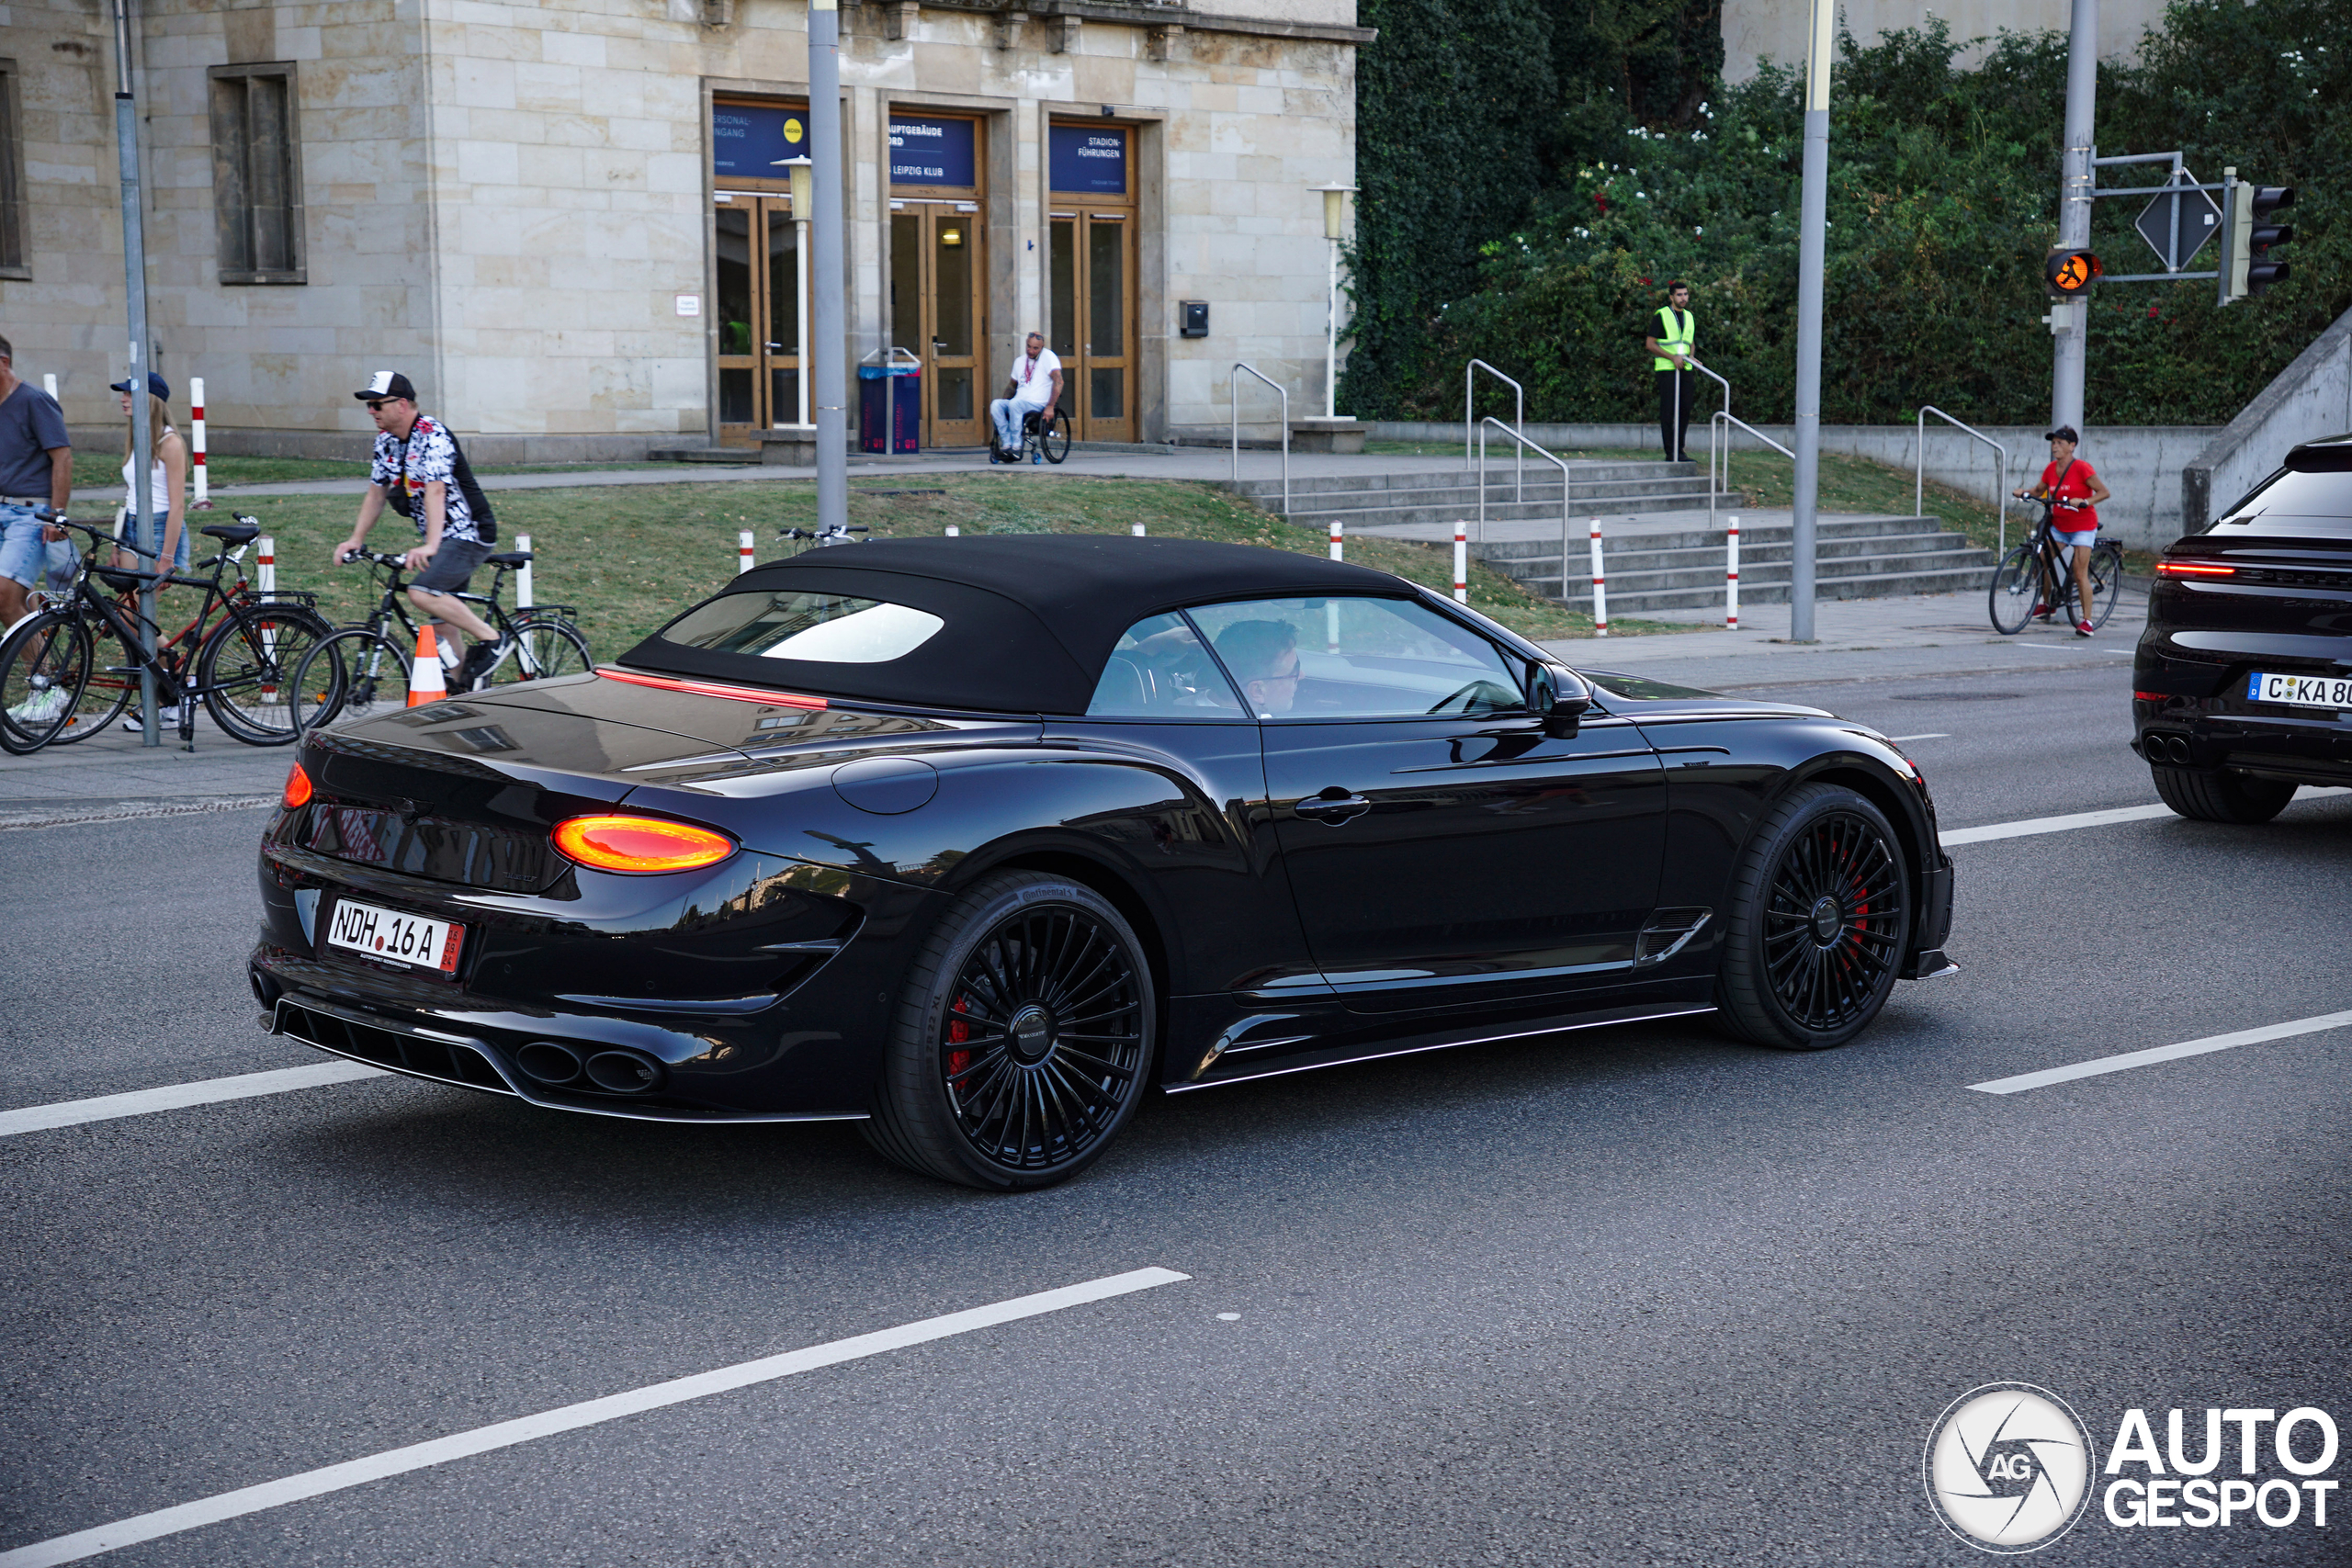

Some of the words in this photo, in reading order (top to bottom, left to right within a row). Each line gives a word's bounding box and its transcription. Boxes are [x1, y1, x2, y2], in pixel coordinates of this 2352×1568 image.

[1088, 137, 1121, 146] STADION-
[1078, 146, 1120, 158] FÜHRUNGEN
[893, 165, 922, 175] LEIPZIG
[923, 167, 944, 176] KLUB
[2268, 677, 2283, 698] C
[2297, 679, 2325, 702] KA
[1022, 887, 1067, 902] Continental
[334, 905, 379, 947] NDH
[448, 930, 458, 941] 06
[445, 942, 456, 953] 09
[442, 954, 452, 965] 24
